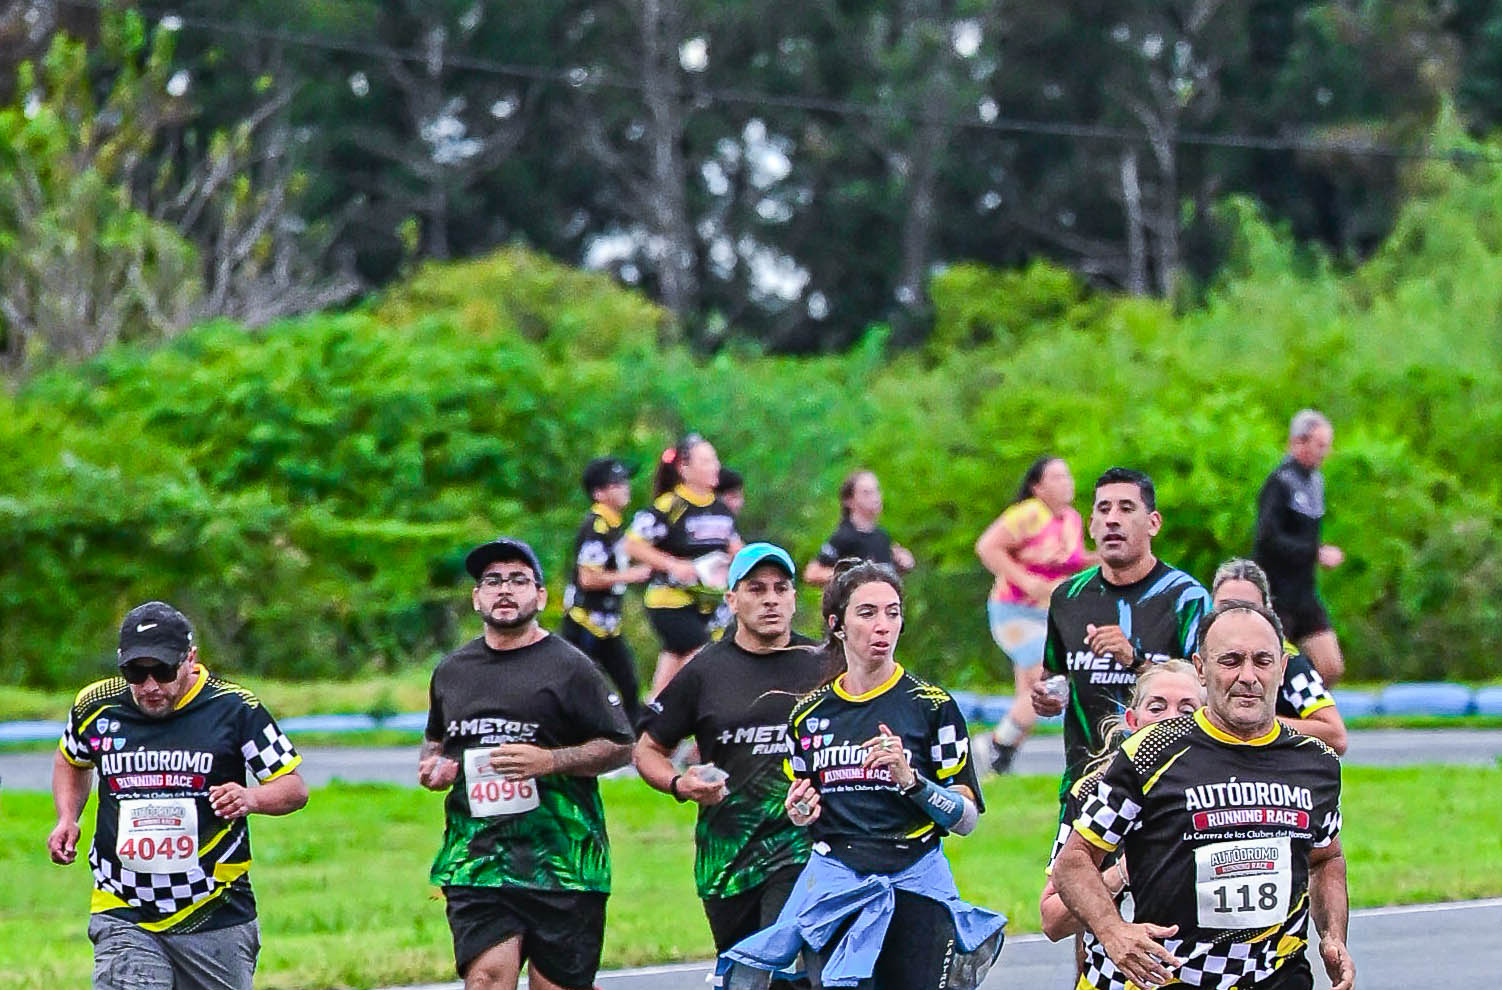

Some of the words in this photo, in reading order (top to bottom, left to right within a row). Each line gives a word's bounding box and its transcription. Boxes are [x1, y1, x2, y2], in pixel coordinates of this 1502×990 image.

[1090, 672, 1136, 684] RUNN
[101, 746, 214, 776] AUTÓDROMO
[165, 774, 194, 788] RACE
[471, 780, 533, 804] 4096
[1184, 777, 1313, 811] AUTÓDROMO
[1206, 810, 1264, 828] RUNNING
[1266, 809, 1299, 826] RACE
[1194, 831, 1222, 840] Carrera
[1224, 831, 1234, 839] de
[1234, 830, 1246, 839] los
[119, 835, 194, 861] 4049
[1210, 846, 1279, 867] AUTÓDROMO
[1213, 883, 1278, 913] 118
